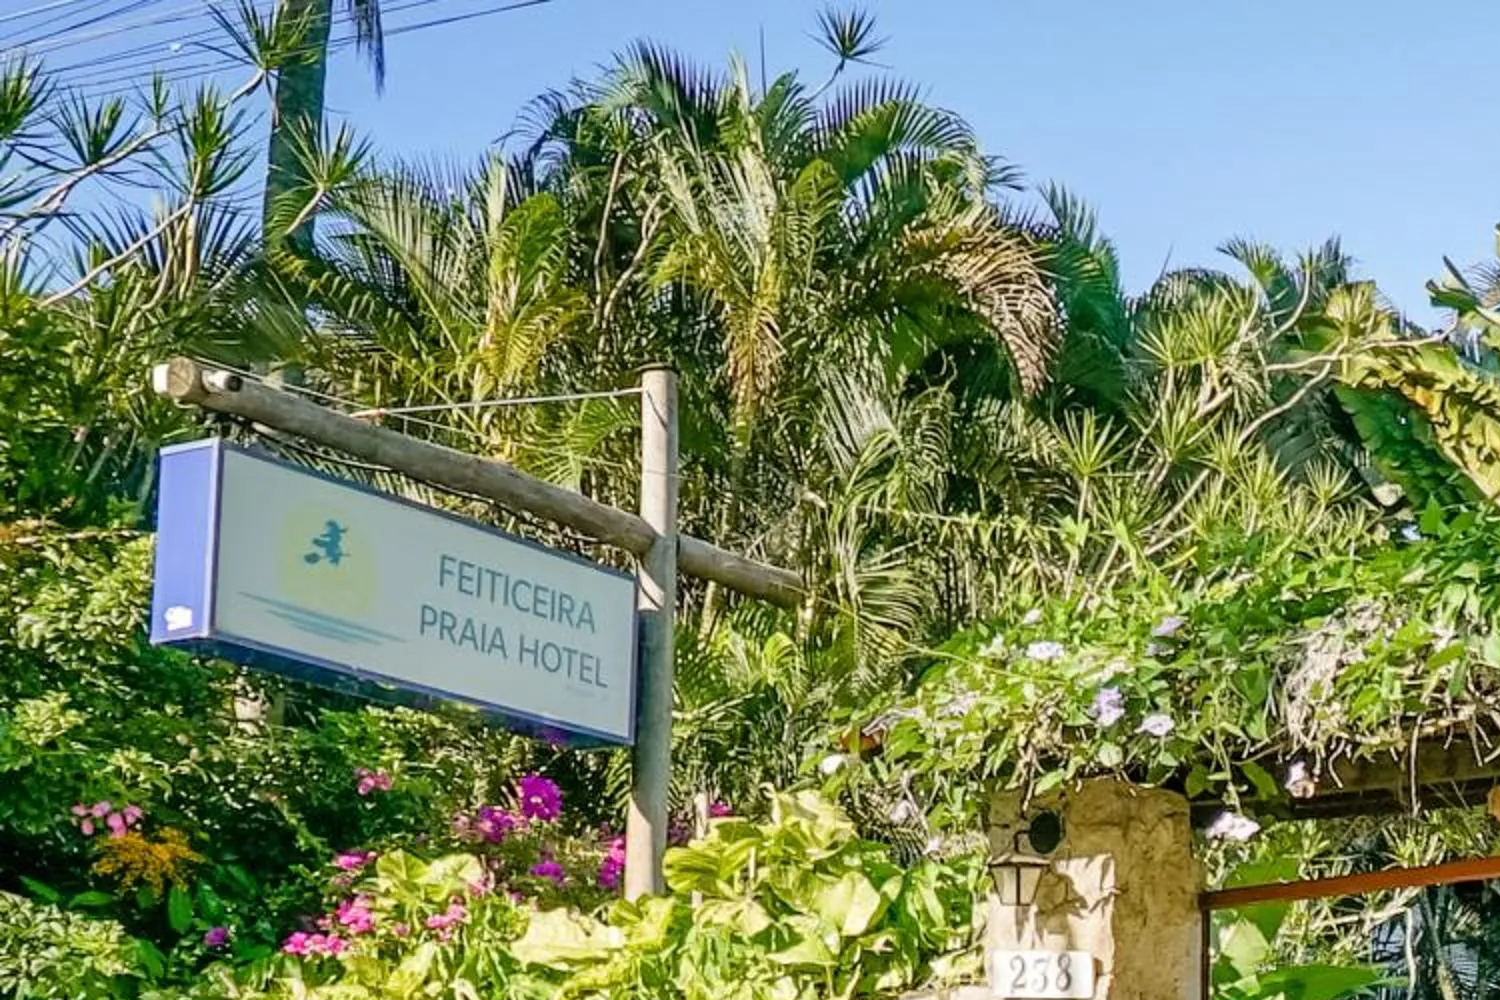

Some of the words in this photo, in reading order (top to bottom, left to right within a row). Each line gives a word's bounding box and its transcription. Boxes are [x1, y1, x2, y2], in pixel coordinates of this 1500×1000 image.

[439, 554, 596, 633] FEITICEIRA
[419, 604, 508, 660] PRAIA
[518, 633, 608, 688] HOTEL
[1010, 953, 1072, 992] 238
